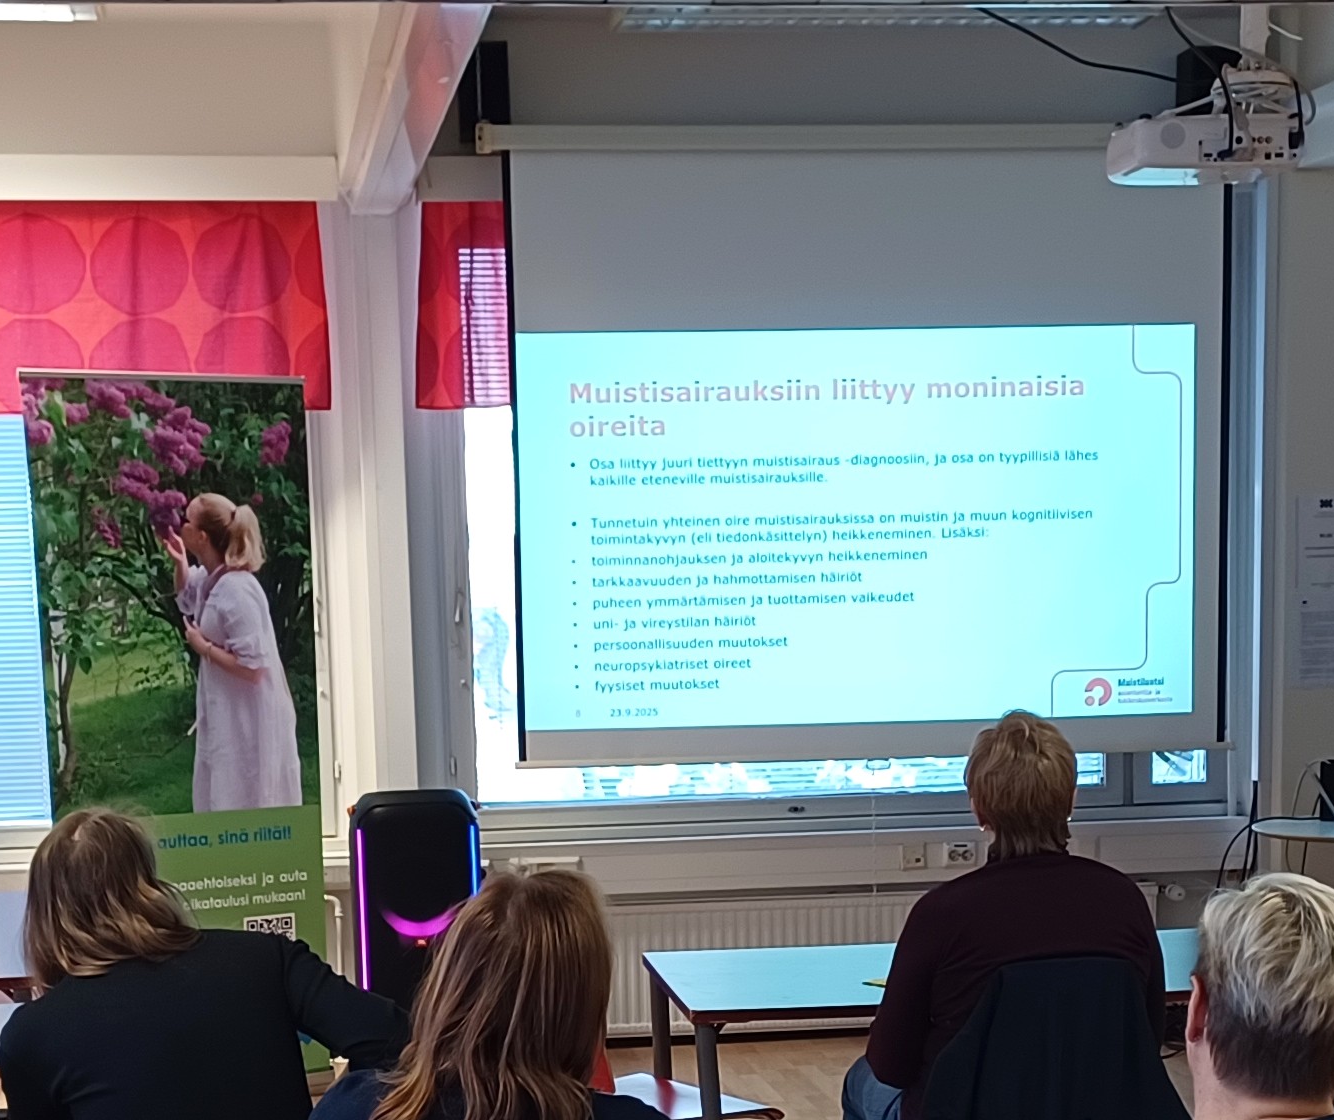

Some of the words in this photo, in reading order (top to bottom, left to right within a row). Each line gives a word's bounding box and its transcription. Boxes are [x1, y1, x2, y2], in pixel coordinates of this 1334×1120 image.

[569, 379, 821, 404] Muistisairauksiin
[832, 378, 916, 405] liittyy
[926, 374, 1085, 399] moninaisia
[569, 414, 666, 438] oireita
[589, 457, 615, 470] Osa
[619, 457, 657, 472] liittyy
[661, 457, 693, 471] juuri
[697, 456, 748, 470] tiettyyn
[753, 455, 840, 468] muistisairaus
[933, 452, 947, 467] ja
[951, 452, 974, 465] osa
[977, 452, 995, 464] on
[999, 450, 1061, 465] tyypillisiä
[1064, 449, 1099, 462] lähes
[589, 473, 637, 486] kaikille
[641, 472, 706, 486] eteneville
[710, 471, 829, 485] muistisairauksille.
[590, 517, 658, 530] Tunnetuin
[662, 515, 721, 530] yhteinen
[725, 514, 750, 527] oire
[754, 512, 875, 526] muistisairauksissa
[879, 513, 896, 524] on
[900, 510, 949, 523] muistin
[952, 511, 965, 525] ja
[970, 511, 1007, 522] muun
[1012, 508, 1093, 523] kognitiivisen
[591, 533, 686, 546] toimintakyvyn
[691, 531, 712, 545] (eli
[717, 530, 827, 544] tiedonkäsittelyn)
[941, 527, 989, 539] Lisäksi:
[591, 553, 727, 567] toiminnanohjauksen
[731, 553, 744, 566] ja
[748, 552, 824, 565] aloitekyvyn
[828, 550, 929, 562] heikkeneminen
[592, 575, 692, 588] tarkkaavuuden
[695, 575, 709, 588] ja
[713, 573, 816, 586] hahmottamisen
[821, 571, 862, 583] häiriöt
[593, 598, 642, 610] puheen
[647, 595, 747, 610] ymmärtämisen
[750, 595, 763, 608] ja
[767, 593, 846, 605] tuottamisen
[851, 591, 915, 604] vaikeudet
[593, 618, 618, 630] uni-
[623, 619, 636, 631] ja
[641, 616, 710, 630] vireystilan
[714, 616, 756, 627] häiriöt
[594, 638, 714, 652] persoonallisuuden
[718, 636, 788, 648] muutokset
[594, 658, 709, 673] neuropsykiatriset
[713, 658, 752, 670] oireet
[594, 680, 645, 694] fyysiset
[650, 679, 720, 691] muutokset
[610, 708, 659, 718] 23.9.2025
[157, 834, 213, 849] auttaa,
[218, 828, 249, 845] sinä
[253, 825, 292, 842] riität!
[261, 872, 274, 887] ja
[279, 869, 308, 883] auta
[252, 889, 306, 905] mukaan!
